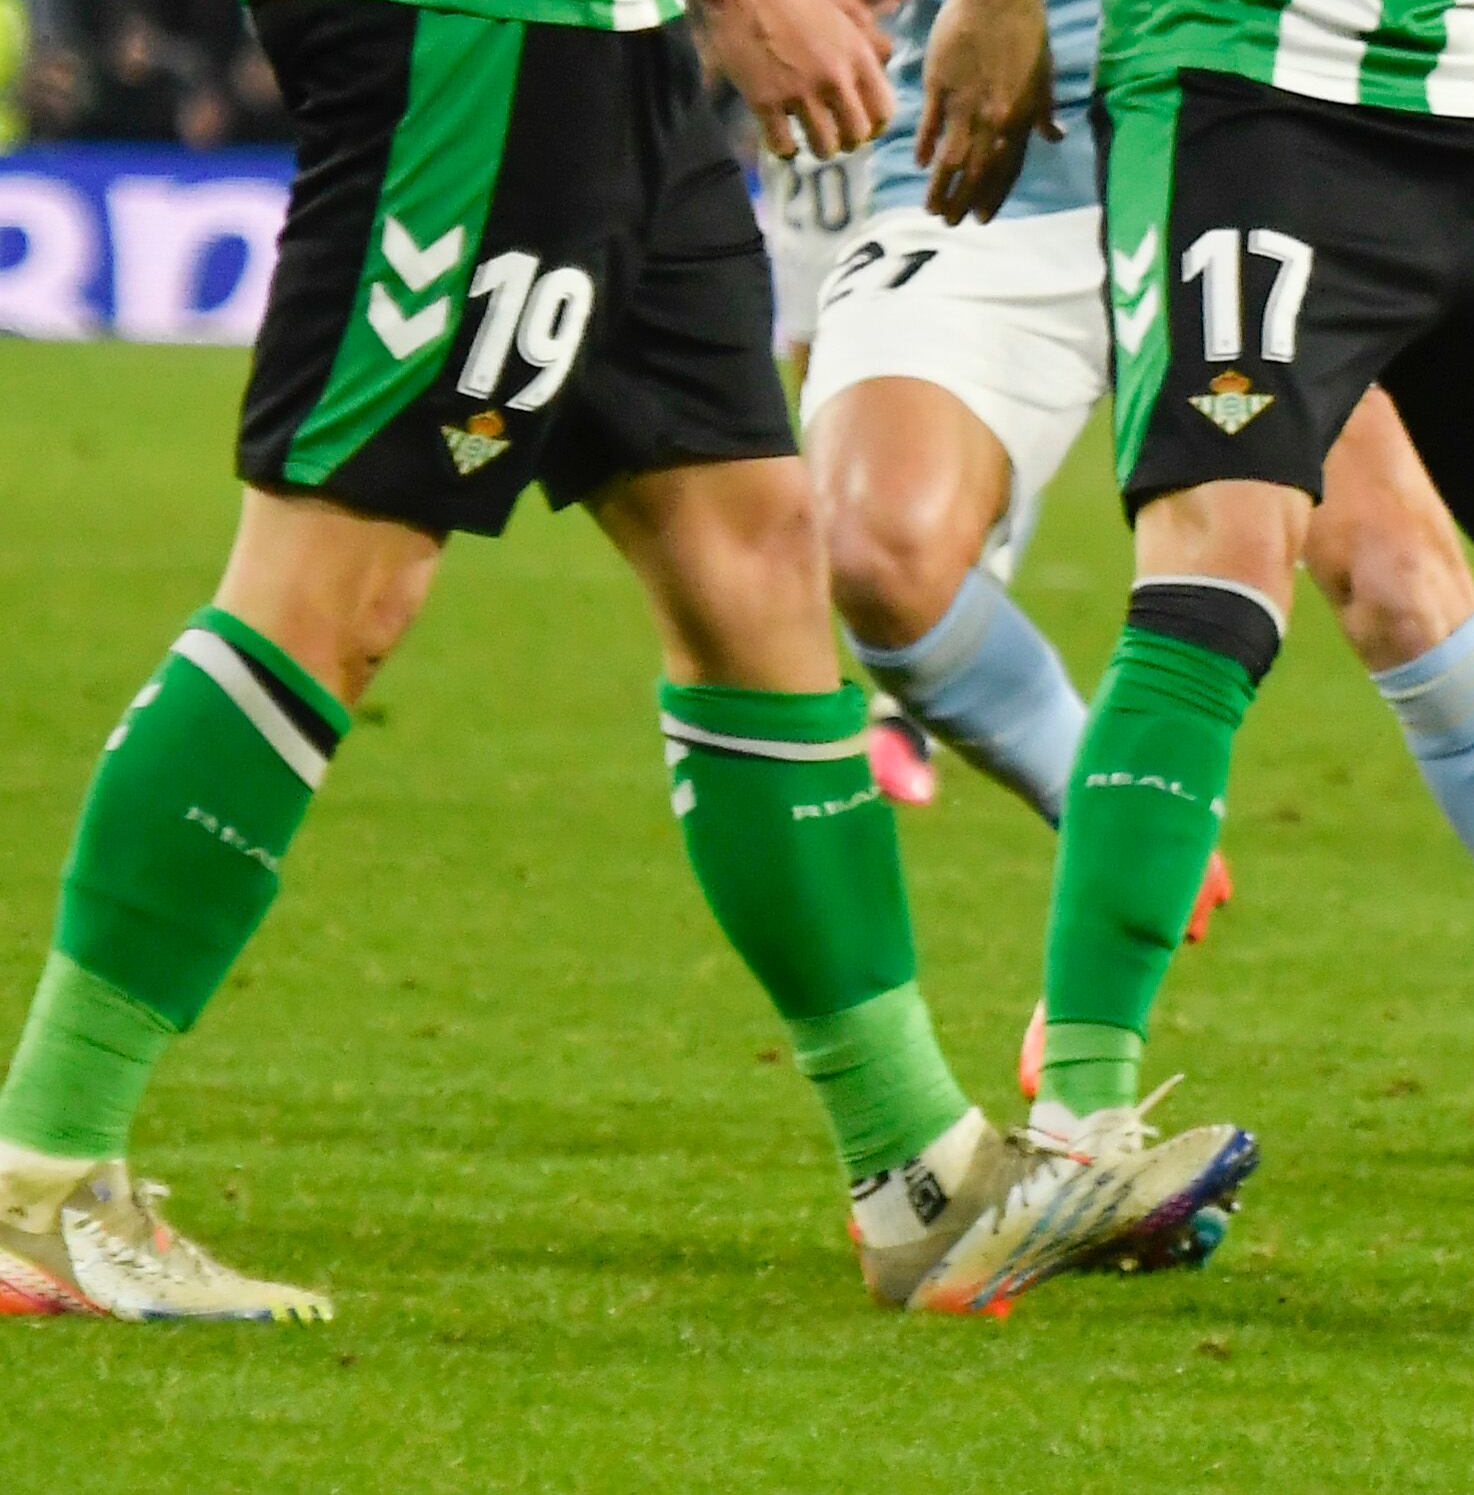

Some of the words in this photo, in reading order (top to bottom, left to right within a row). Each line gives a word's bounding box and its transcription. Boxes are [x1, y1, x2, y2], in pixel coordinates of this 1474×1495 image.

[456, 250, 594, 412] 19
[822, 241, 939, 312] 21
[1181, 228, 1315, 363] 17
